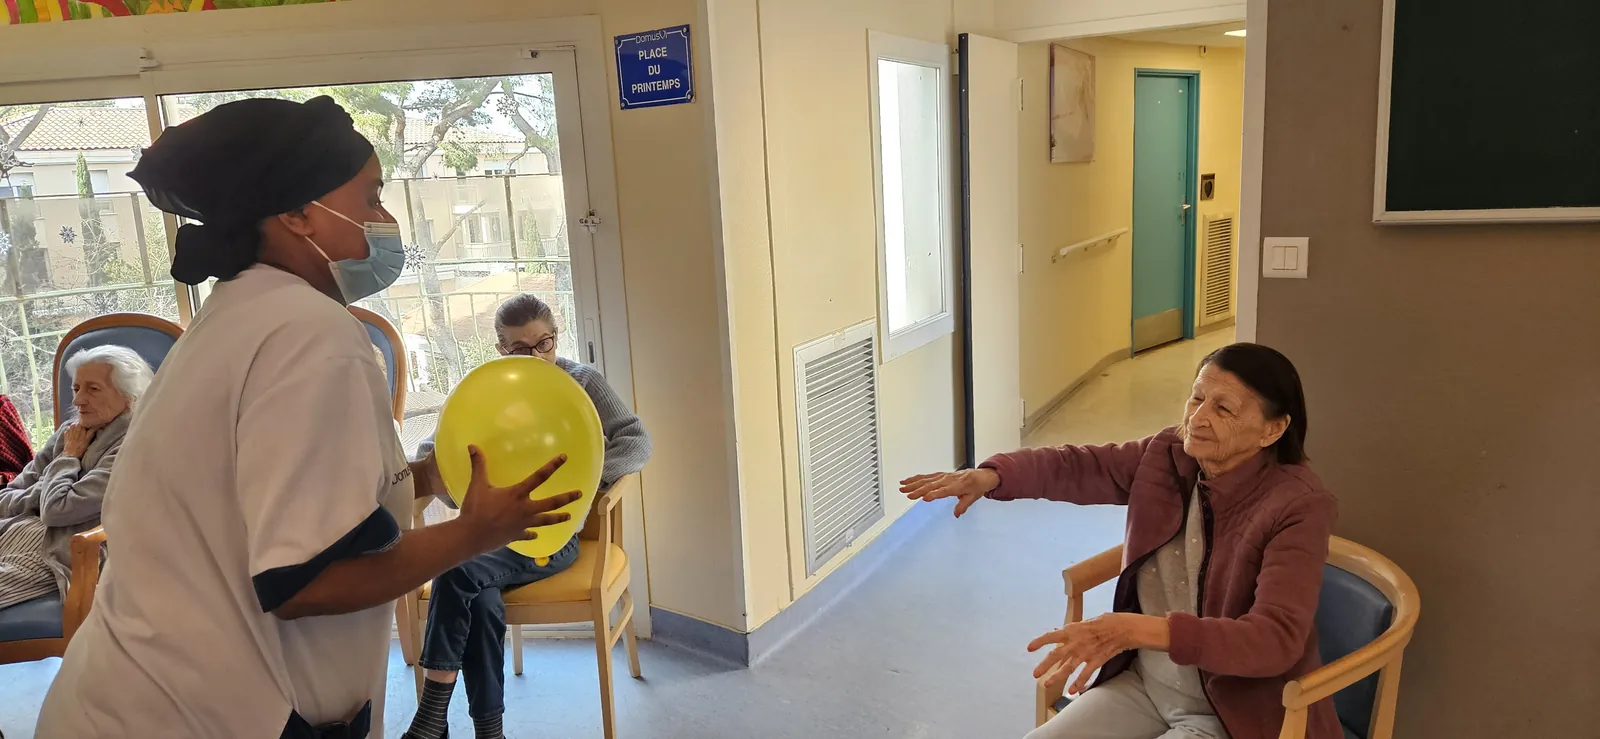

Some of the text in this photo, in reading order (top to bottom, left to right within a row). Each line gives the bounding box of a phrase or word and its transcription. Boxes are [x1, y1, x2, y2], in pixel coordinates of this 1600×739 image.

[638, 47, 668, 61] PLACE
[648, 64, 661, 76] DU
[631, 78, 681, 94] PRINTEMPS
